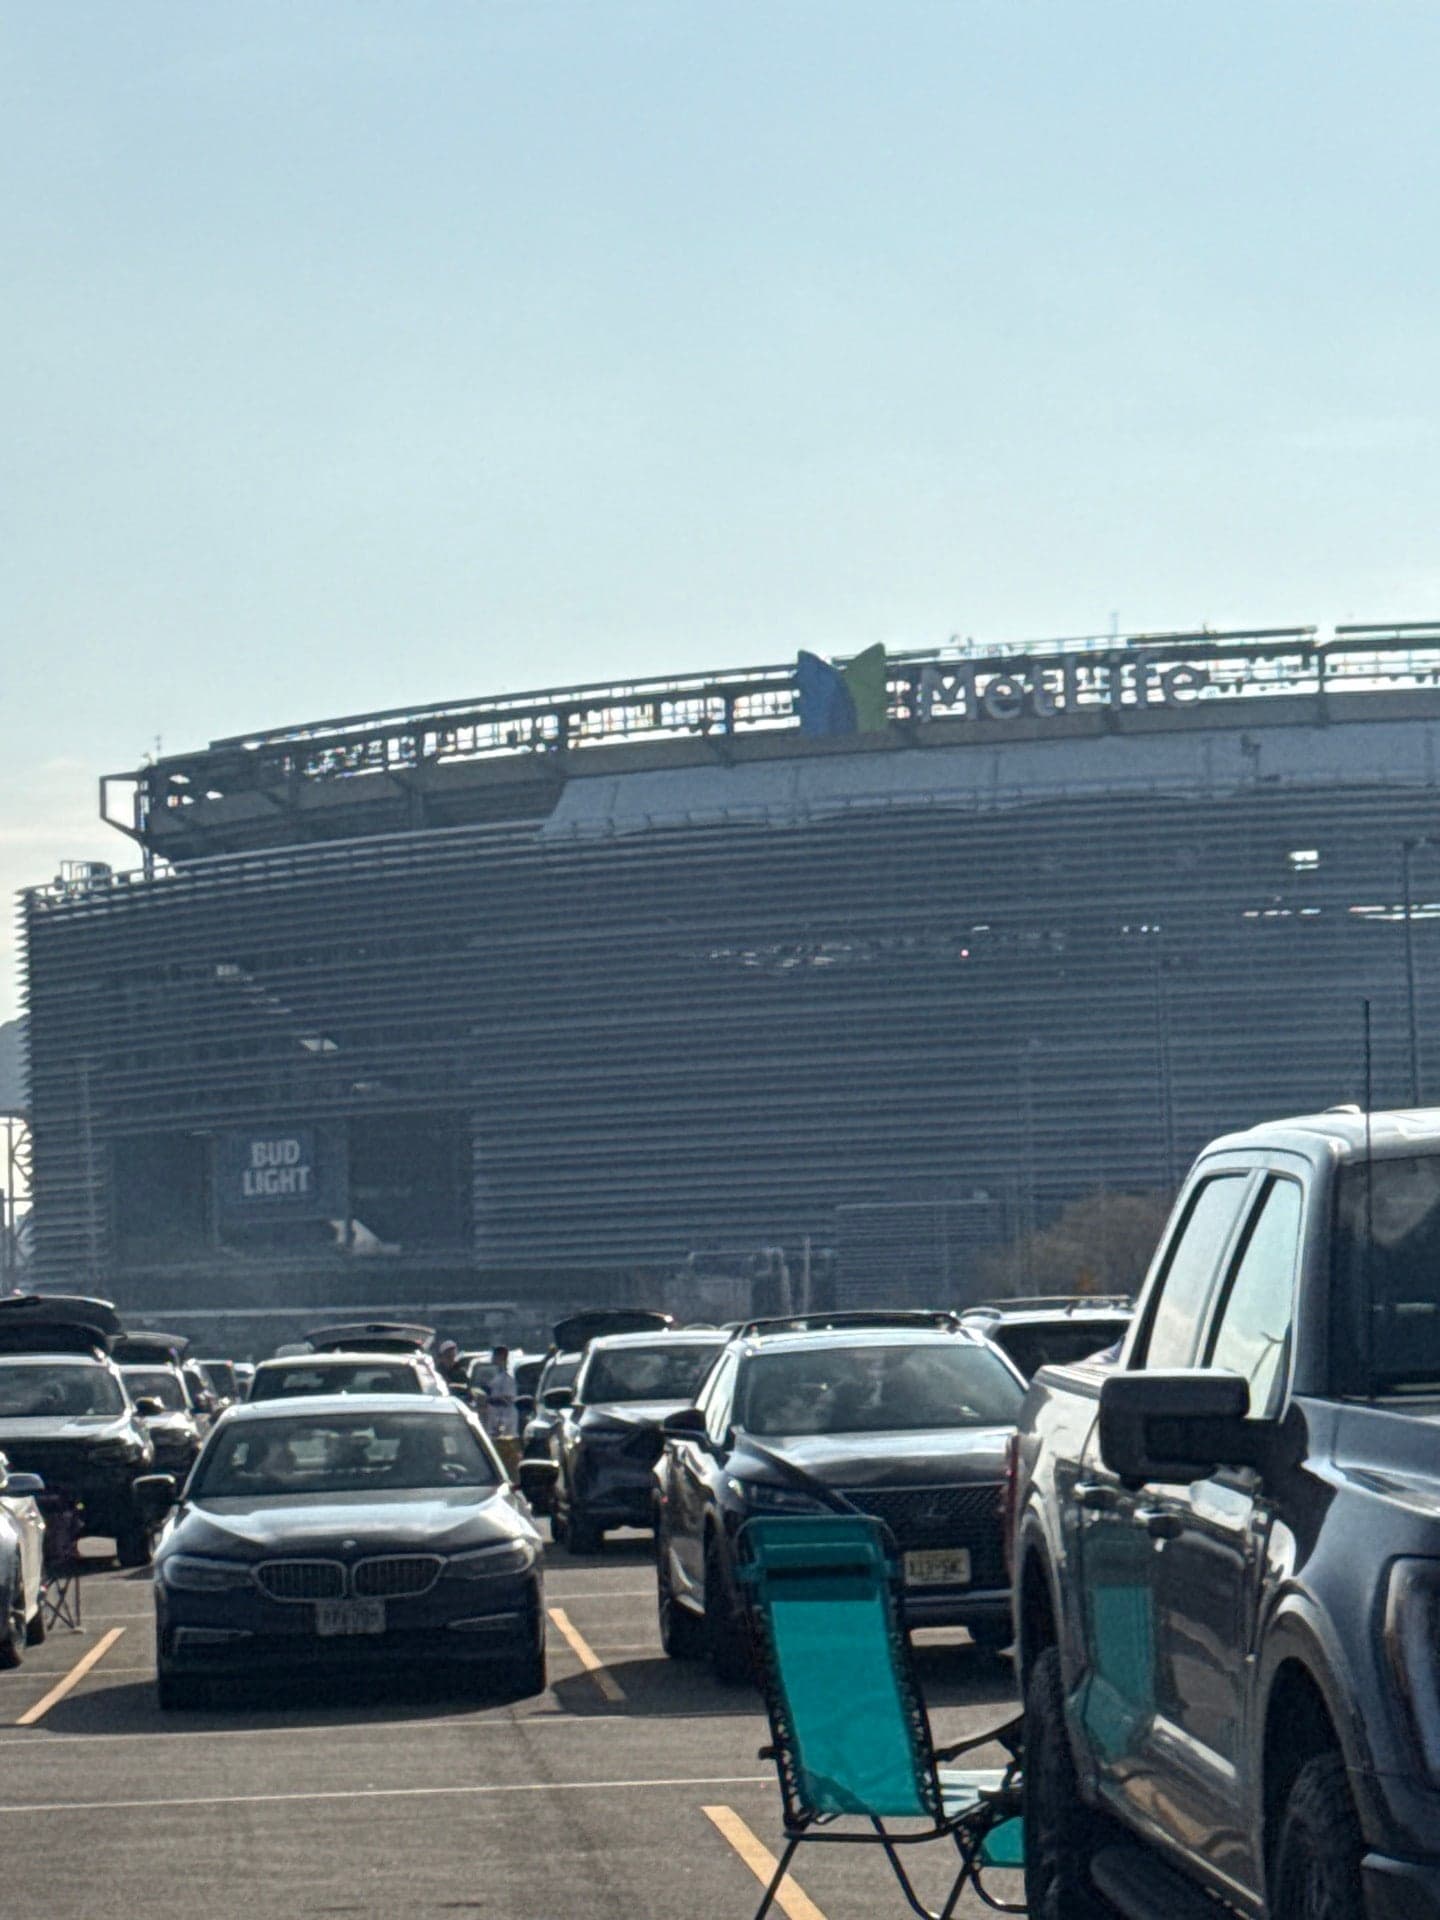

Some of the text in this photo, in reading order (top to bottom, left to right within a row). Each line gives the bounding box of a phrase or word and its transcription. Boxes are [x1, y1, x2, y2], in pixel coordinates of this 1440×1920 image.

[919, 650, 1206, 722] MetLife
[251, 1140, 300, 1167] BUD
[242, 1166, 310, 1196] LIGHT
